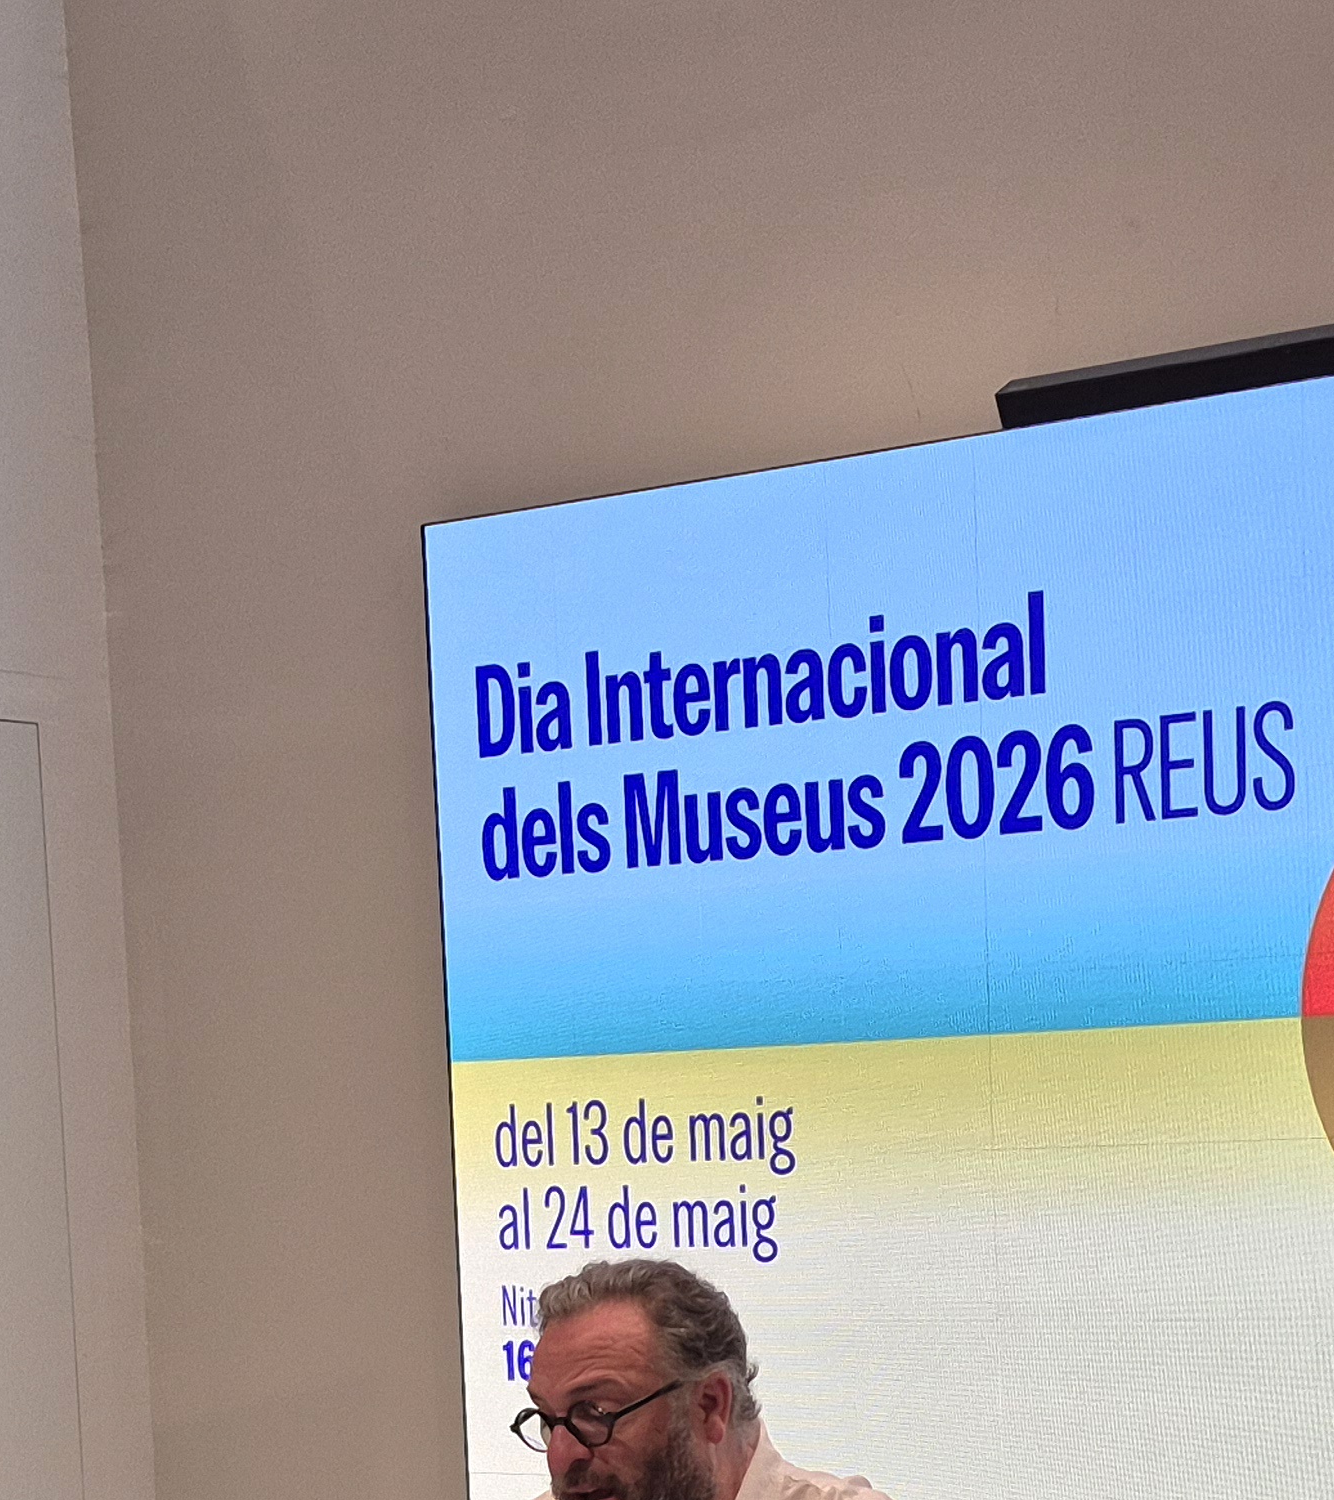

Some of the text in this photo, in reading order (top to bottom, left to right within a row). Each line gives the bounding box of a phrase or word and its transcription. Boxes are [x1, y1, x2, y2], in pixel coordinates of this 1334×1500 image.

[474, 590, 1047, 759] Dia Internacional
[482, 700, 1297, 882] dels Museus 2026 REUS
[495, 1096, 796, 1175] del 13 de maig
[498, 1184, 778, 1263] al 24 de maig
[502, 1339, 535, 1381] 16
